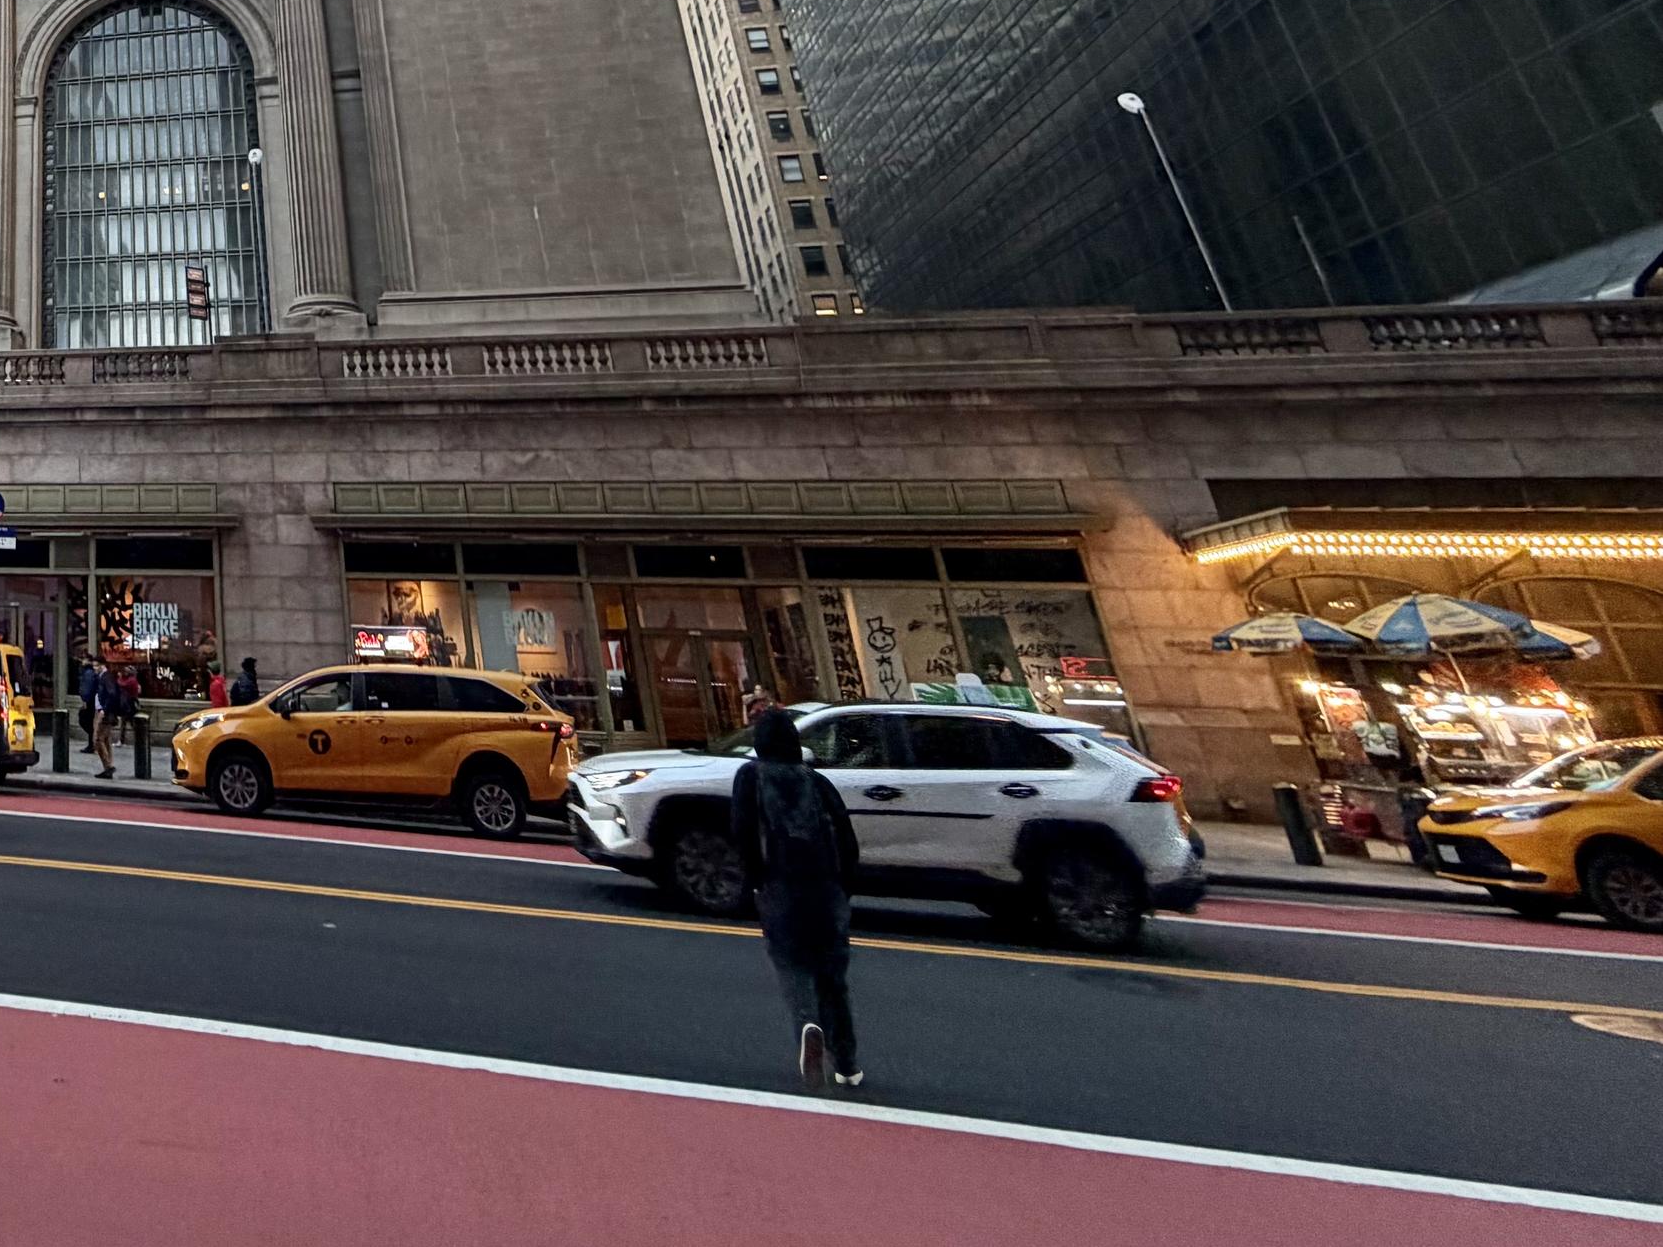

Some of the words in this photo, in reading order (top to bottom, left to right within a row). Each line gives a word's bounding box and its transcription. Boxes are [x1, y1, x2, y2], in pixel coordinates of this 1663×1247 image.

[133, 602, 178, 619] BRKLN
[133, 619, 178, 635] BLOKE
[313, 733, 327, 751] T
